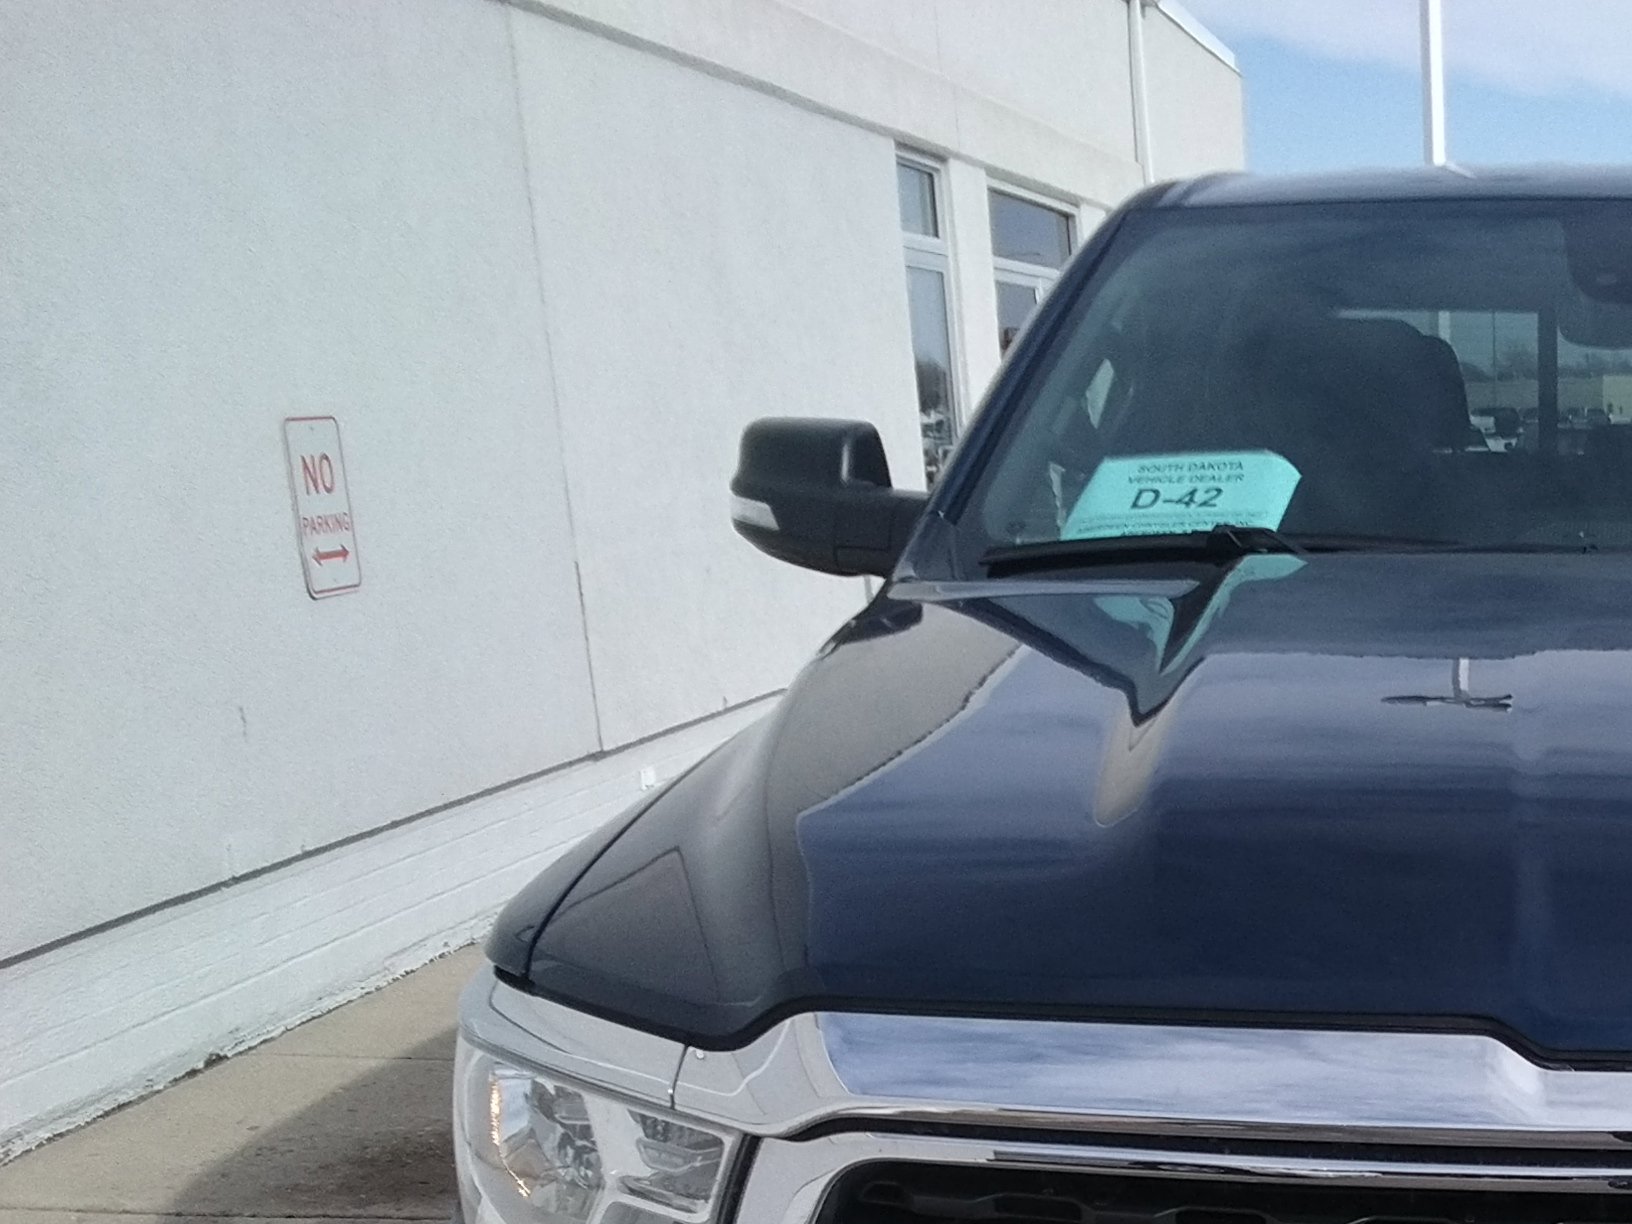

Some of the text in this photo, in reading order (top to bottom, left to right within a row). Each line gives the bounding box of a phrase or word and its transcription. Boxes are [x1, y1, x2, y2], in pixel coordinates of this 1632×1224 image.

[300, 452, 335, 496] NO
[1138, 460, 1244, 473] SOUTH DAKOTA
[1128, 473, 1245, 485] VEHICLE DEALER
[1130, 487, 1224, 509] D-42
[302, 512, 350, 536] PARKING
